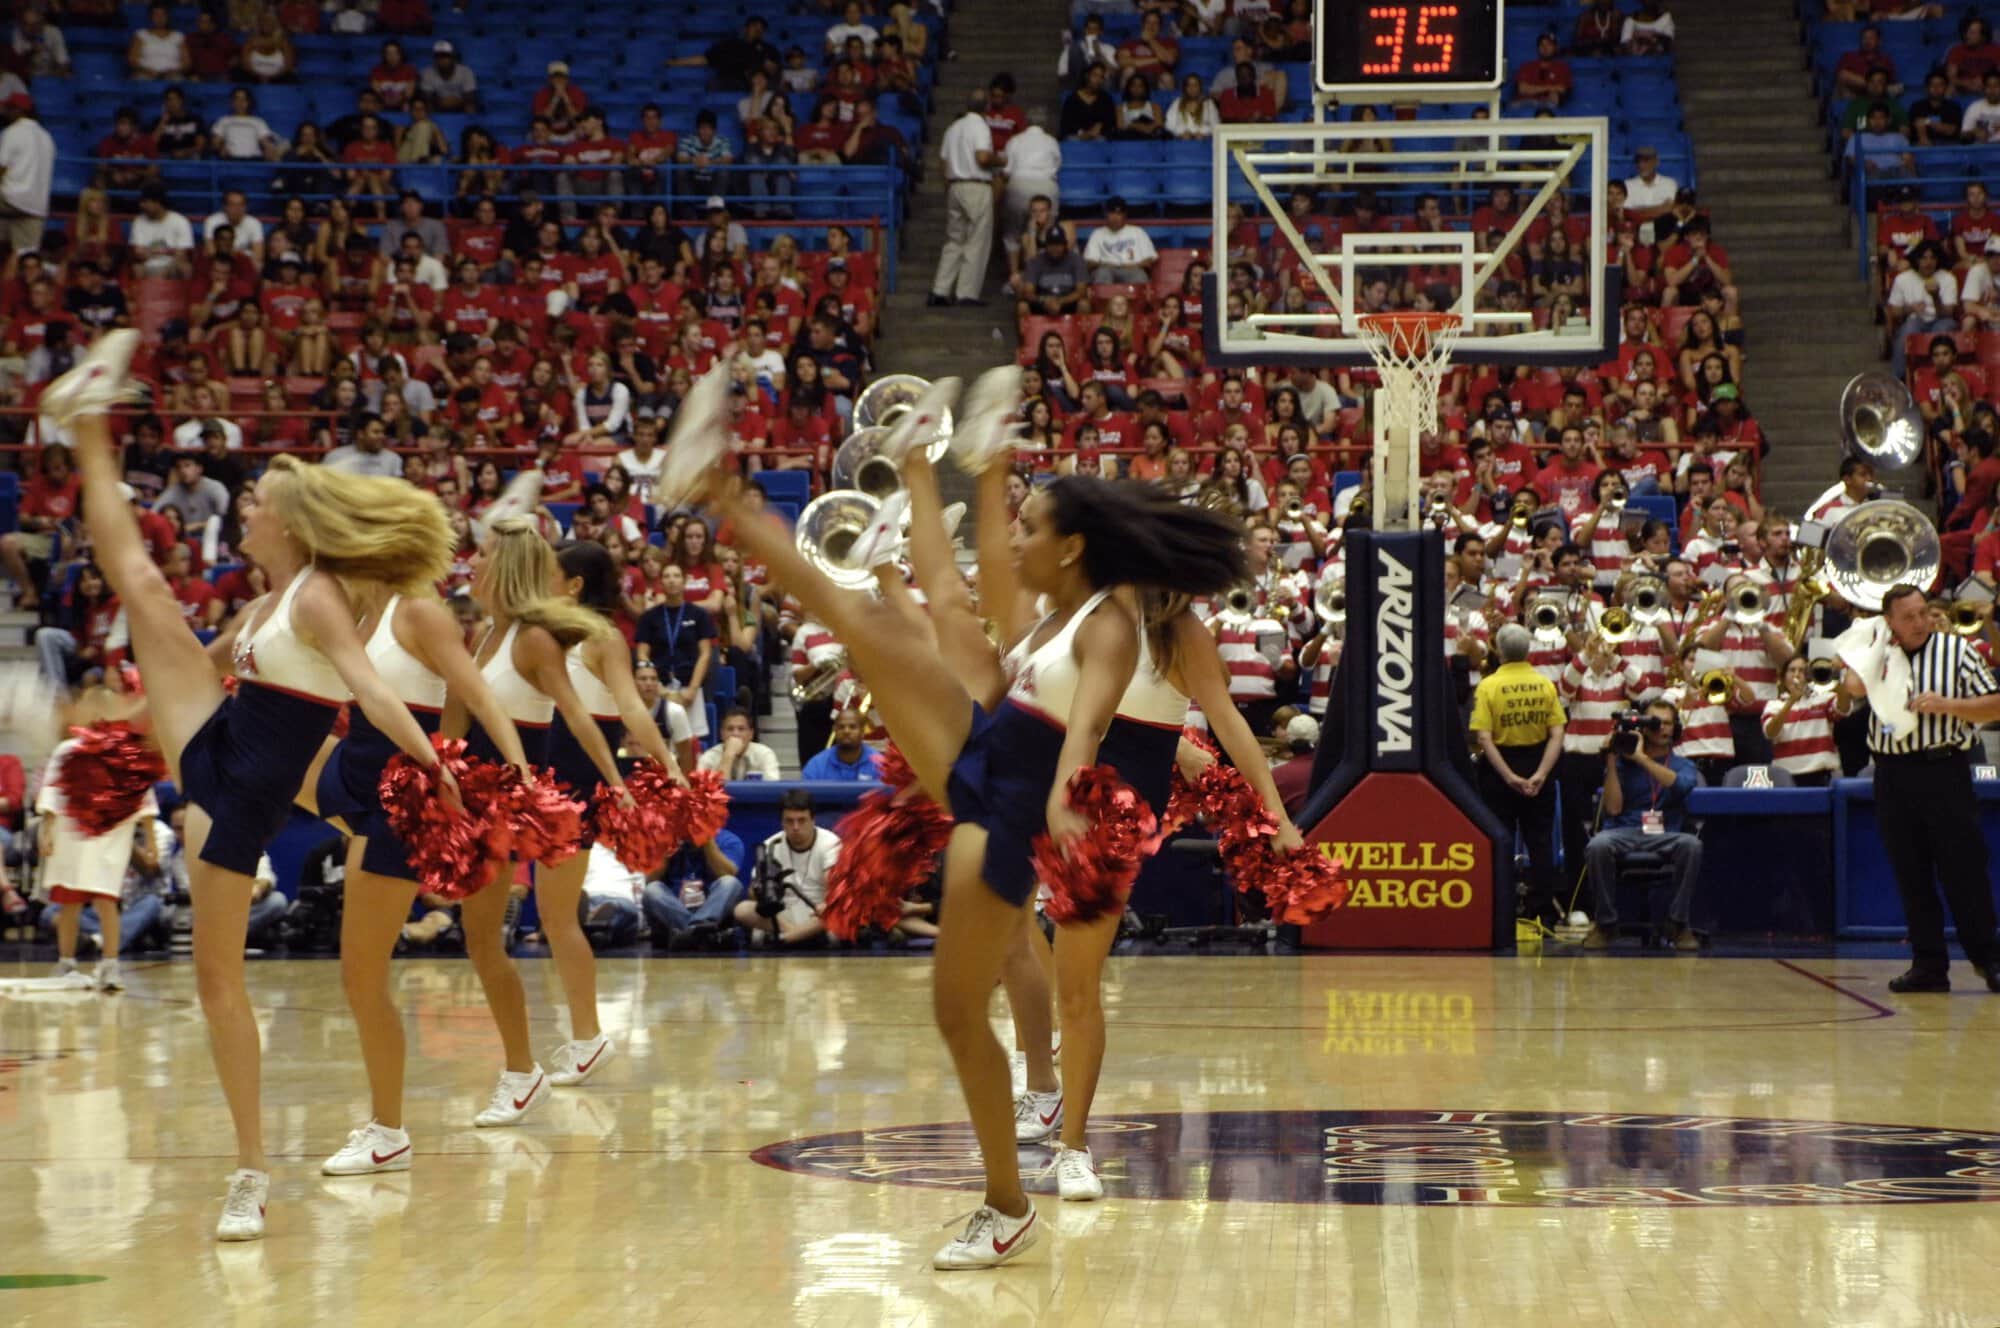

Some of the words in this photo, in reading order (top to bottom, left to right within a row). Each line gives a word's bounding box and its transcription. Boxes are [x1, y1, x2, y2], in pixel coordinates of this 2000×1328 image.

[1363, 6, 1458, 74] 35
[1377, 548, 1413, 752] ARIZONA
[1502, 683, 1545, 694] EVENT
[1507, 697, 1546, 708] STAFF
[1501, 710, 1553, 727] SECURITY
[1317, 842, 1475, 872] WELLS
[1347, 879, 1473, 908] ARGO
